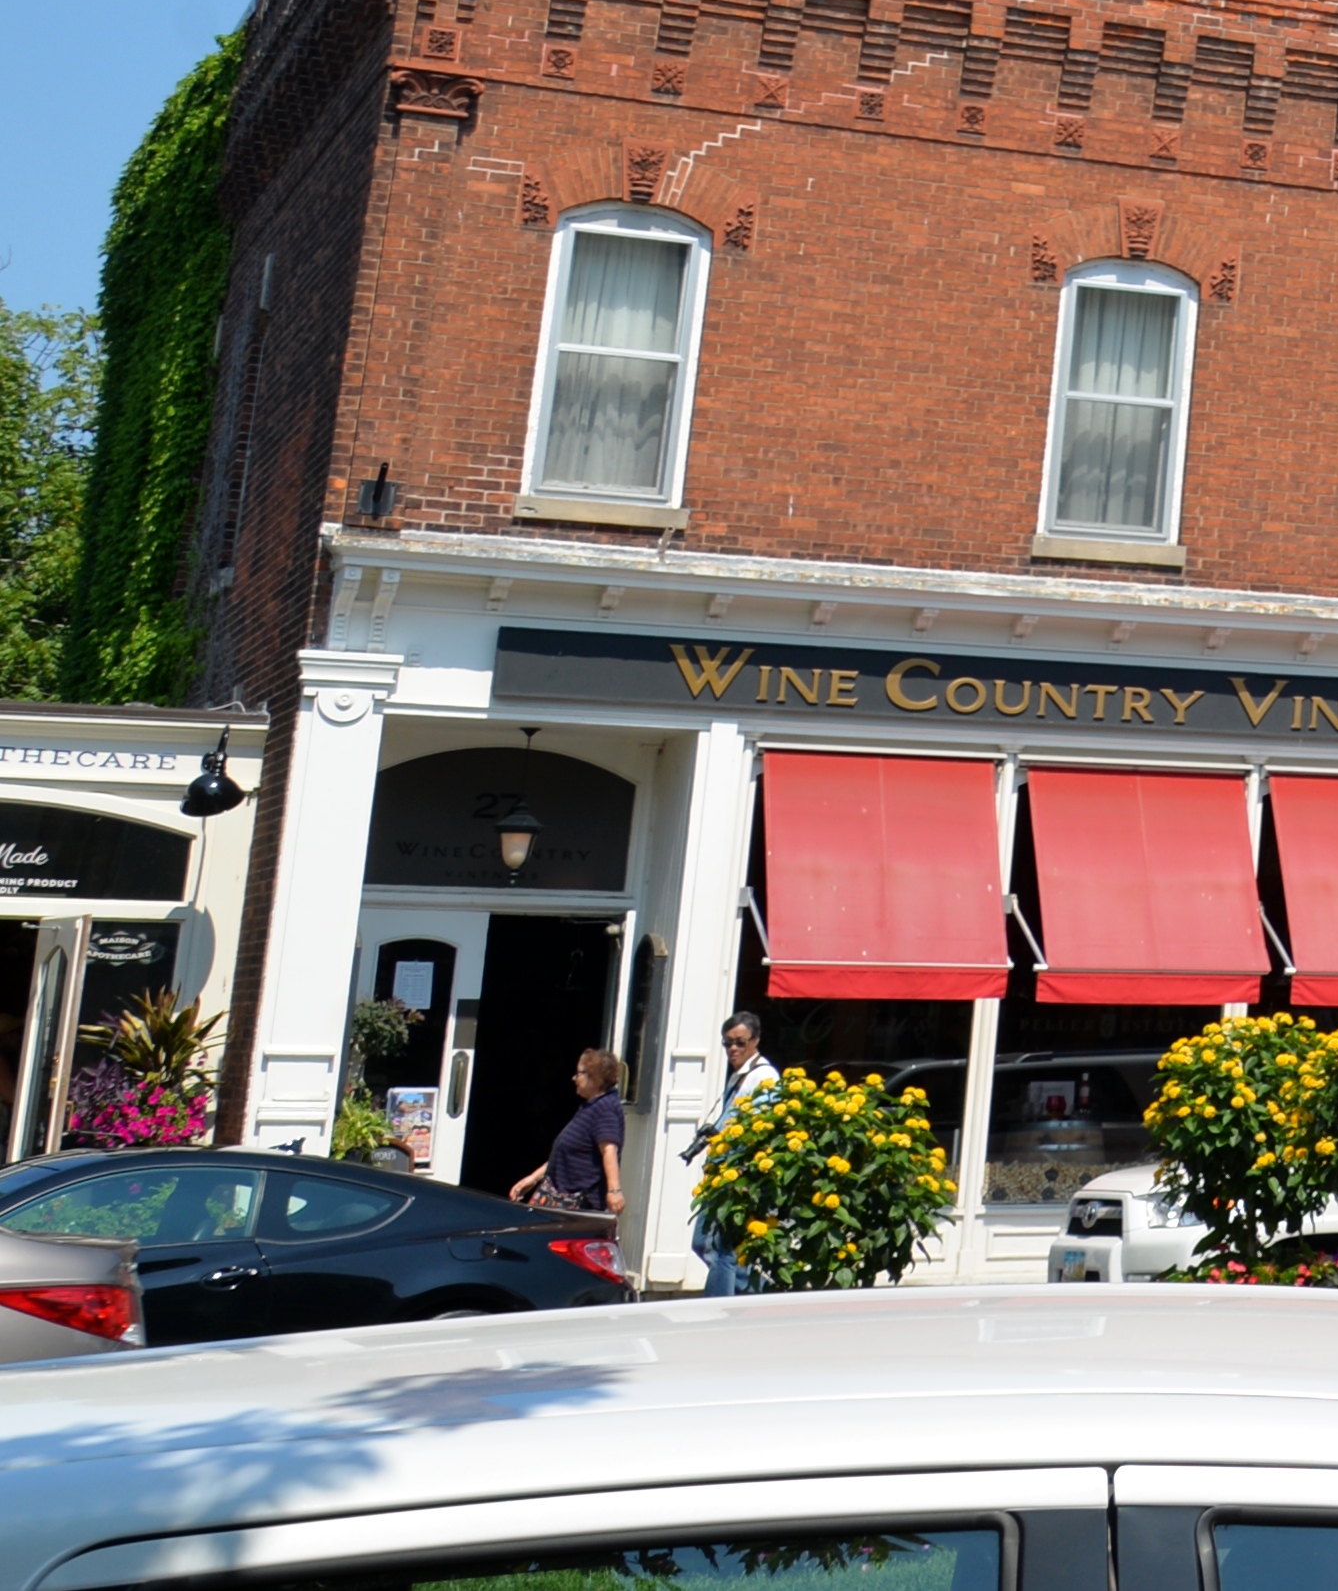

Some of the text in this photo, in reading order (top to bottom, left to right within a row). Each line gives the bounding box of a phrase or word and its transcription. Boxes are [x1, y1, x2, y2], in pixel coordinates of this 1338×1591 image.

[670, 643, 860, 707] WINE
[885, 658, 1205, 725] COUNTRY
[473, 792, 525, 819] 27
[445, 870, 539, 880] VINTNRS
[27, 878, 78, 888] PRODUCT
[98, 937, 139, 945] MAISON
